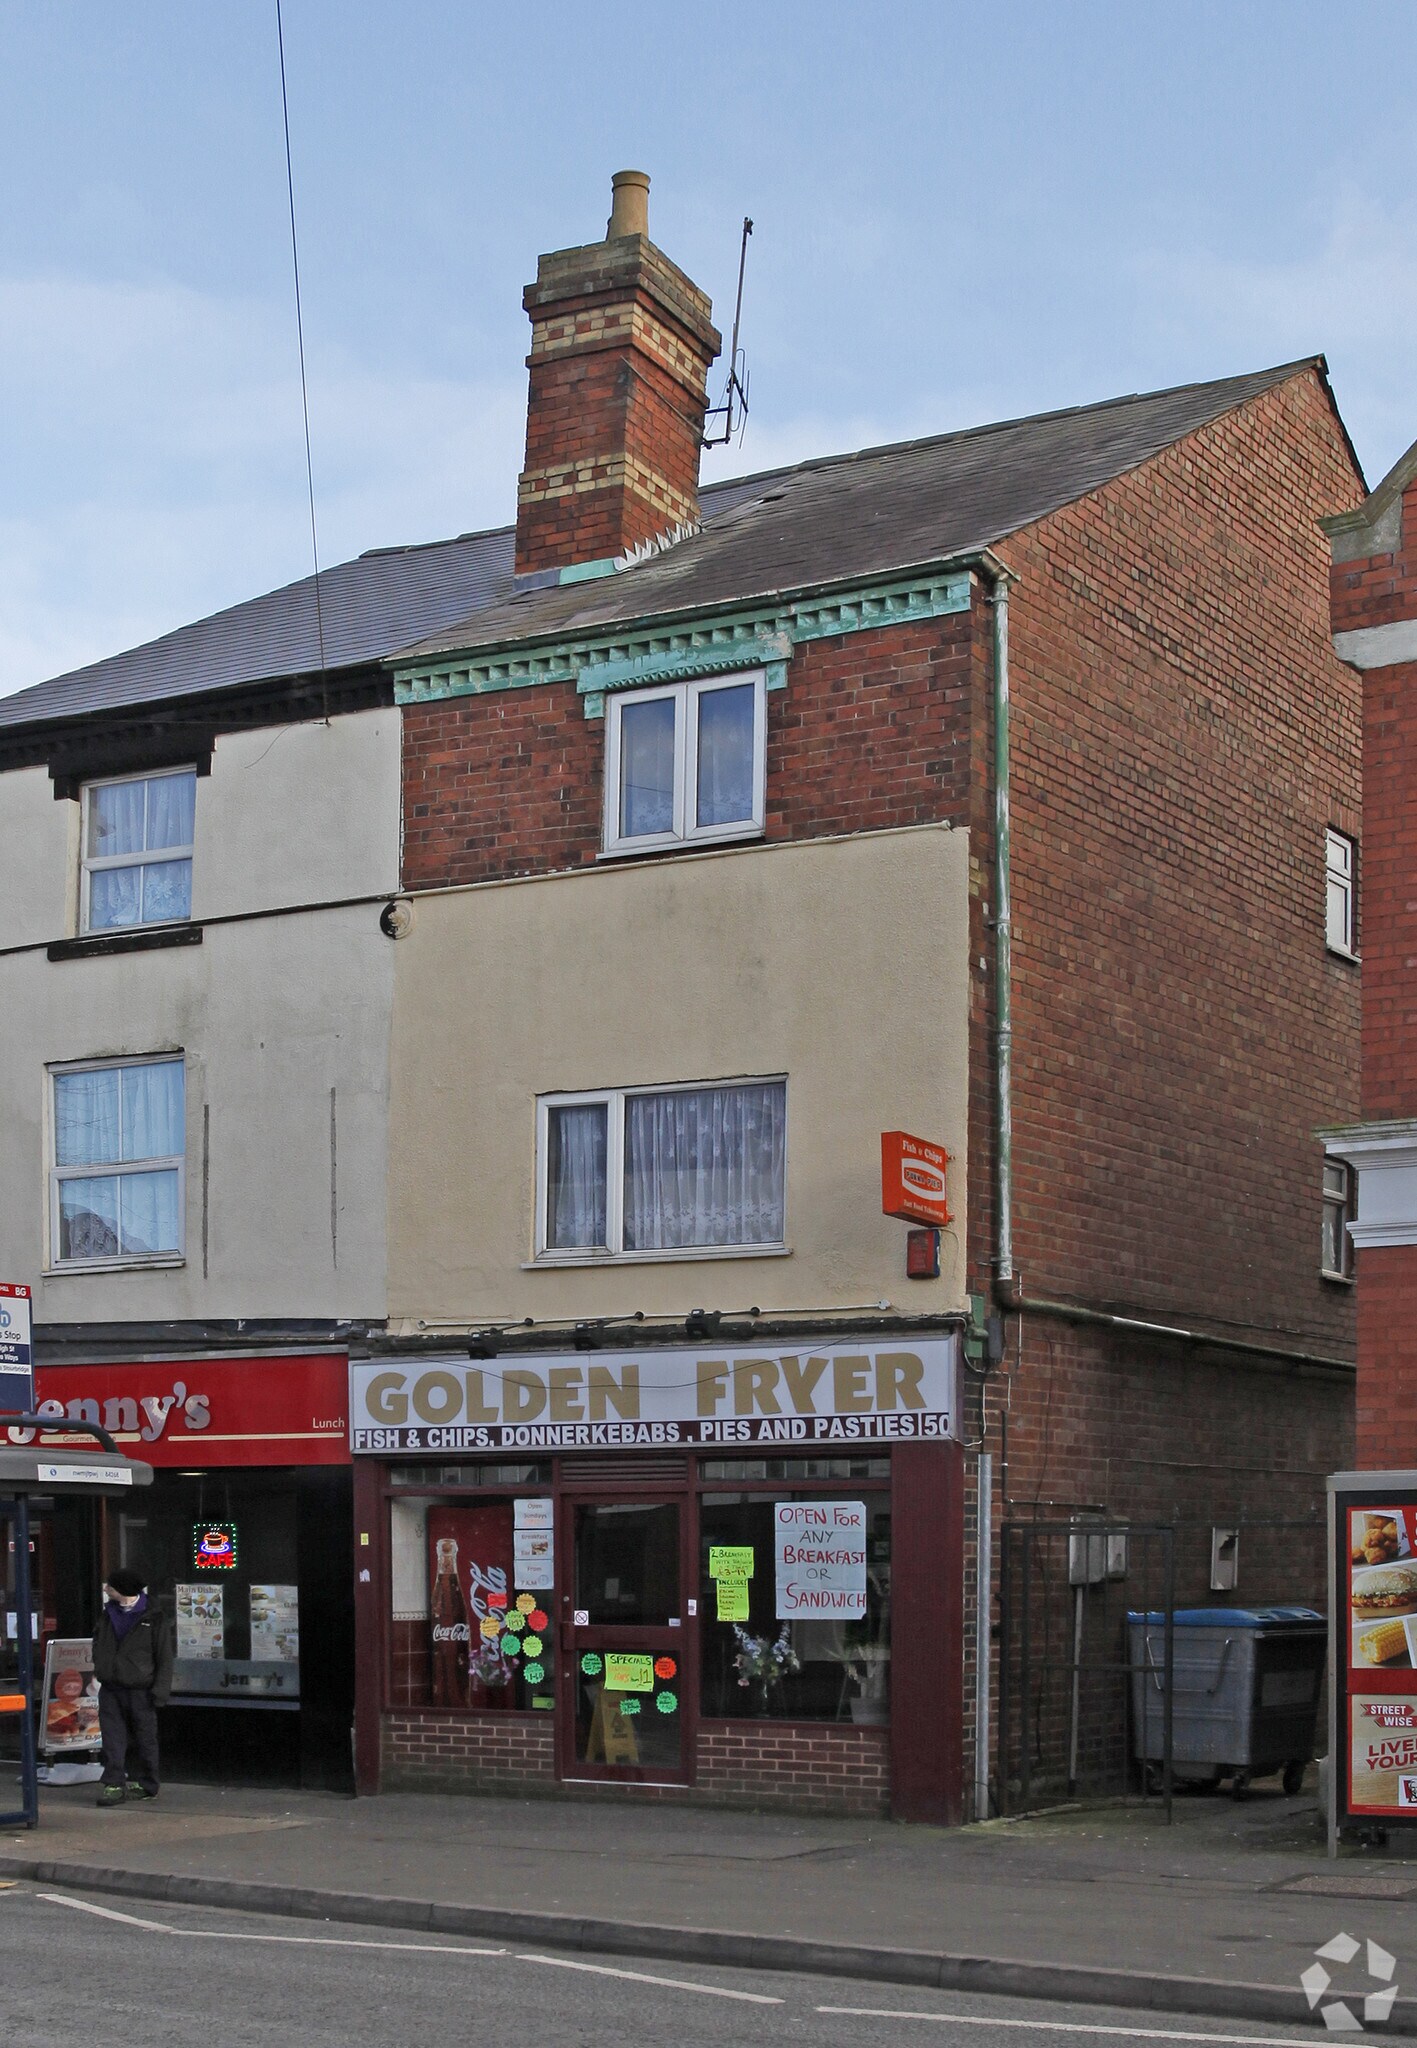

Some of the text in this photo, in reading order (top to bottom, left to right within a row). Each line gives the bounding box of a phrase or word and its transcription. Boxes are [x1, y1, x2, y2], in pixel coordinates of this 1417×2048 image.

[902, 1139, 917, 1154] Fish
[924, 1147, 943, 1164] Chips
[15, 1286, 27, 1297] BG
[4, 1330, 21, 1341] Stop
[365, 1352, 928, 1426] GOLDEN FRYER
[312, 1417, 345, 1429] Lunch
[354, 1428, 400, 1449] FISH
[406, 1429, 421, 1448] &
[700, 1420, 751, 1441] PIES
[757, 1418, 807, 1440] AND
[814, 1415, 915, 1439] PASTIES
[779, 1507, 861, 1526] OPEN FOR
[799, 1530, 834, 1543] ANY
[196, 1552, 235, 1567] CAFE
[783, 1545, 866, 1564] BREAKFAST
[806, 1568, 832, 1580] OR
[784, 1582, 866, 1610] SANDWICH
[610, 1654, 652, 1666] SPECIALS
[1370, 1705, 1406, 1715] STREET
[1384, 1716, 1413, 1726] WISE
[1368, 1738, 1417, 1757] LIVE
